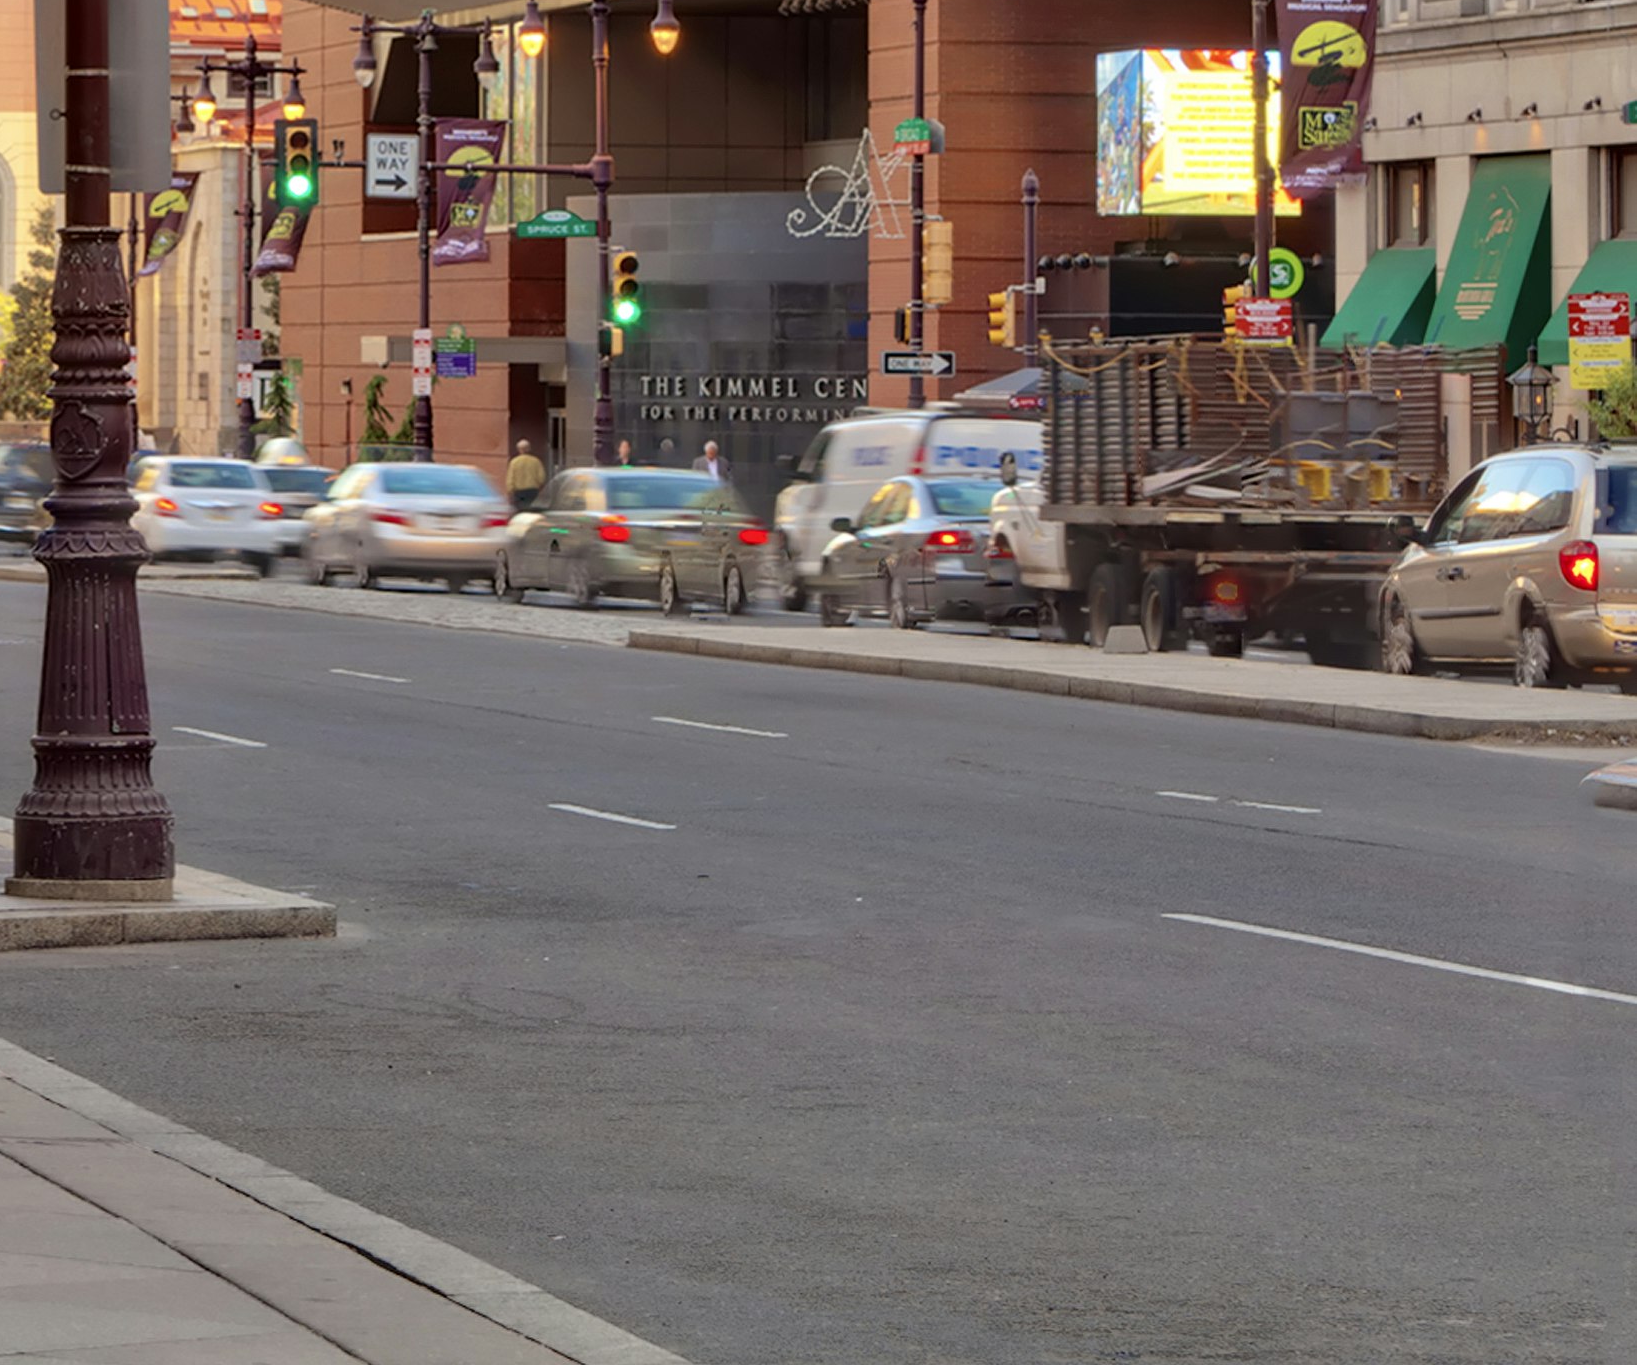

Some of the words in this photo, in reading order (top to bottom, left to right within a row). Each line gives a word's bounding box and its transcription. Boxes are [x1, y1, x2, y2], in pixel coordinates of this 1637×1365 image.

[377, 141, 409, 155] ONE
[376, 158, 409, 171] WAY
[527, 225, 567, 234] SPRUCE
[891, 359, 909, 368] ONE
[641, 376, 685, 396] THE
[699, 376, 798, 397] KIMMEL
[815, 378, 867, 398] CEN
[641, 406, 674, 419] FOR
[683, 406, 715, 420] THE
[729, 407, 849, 421] PERFORMIN
